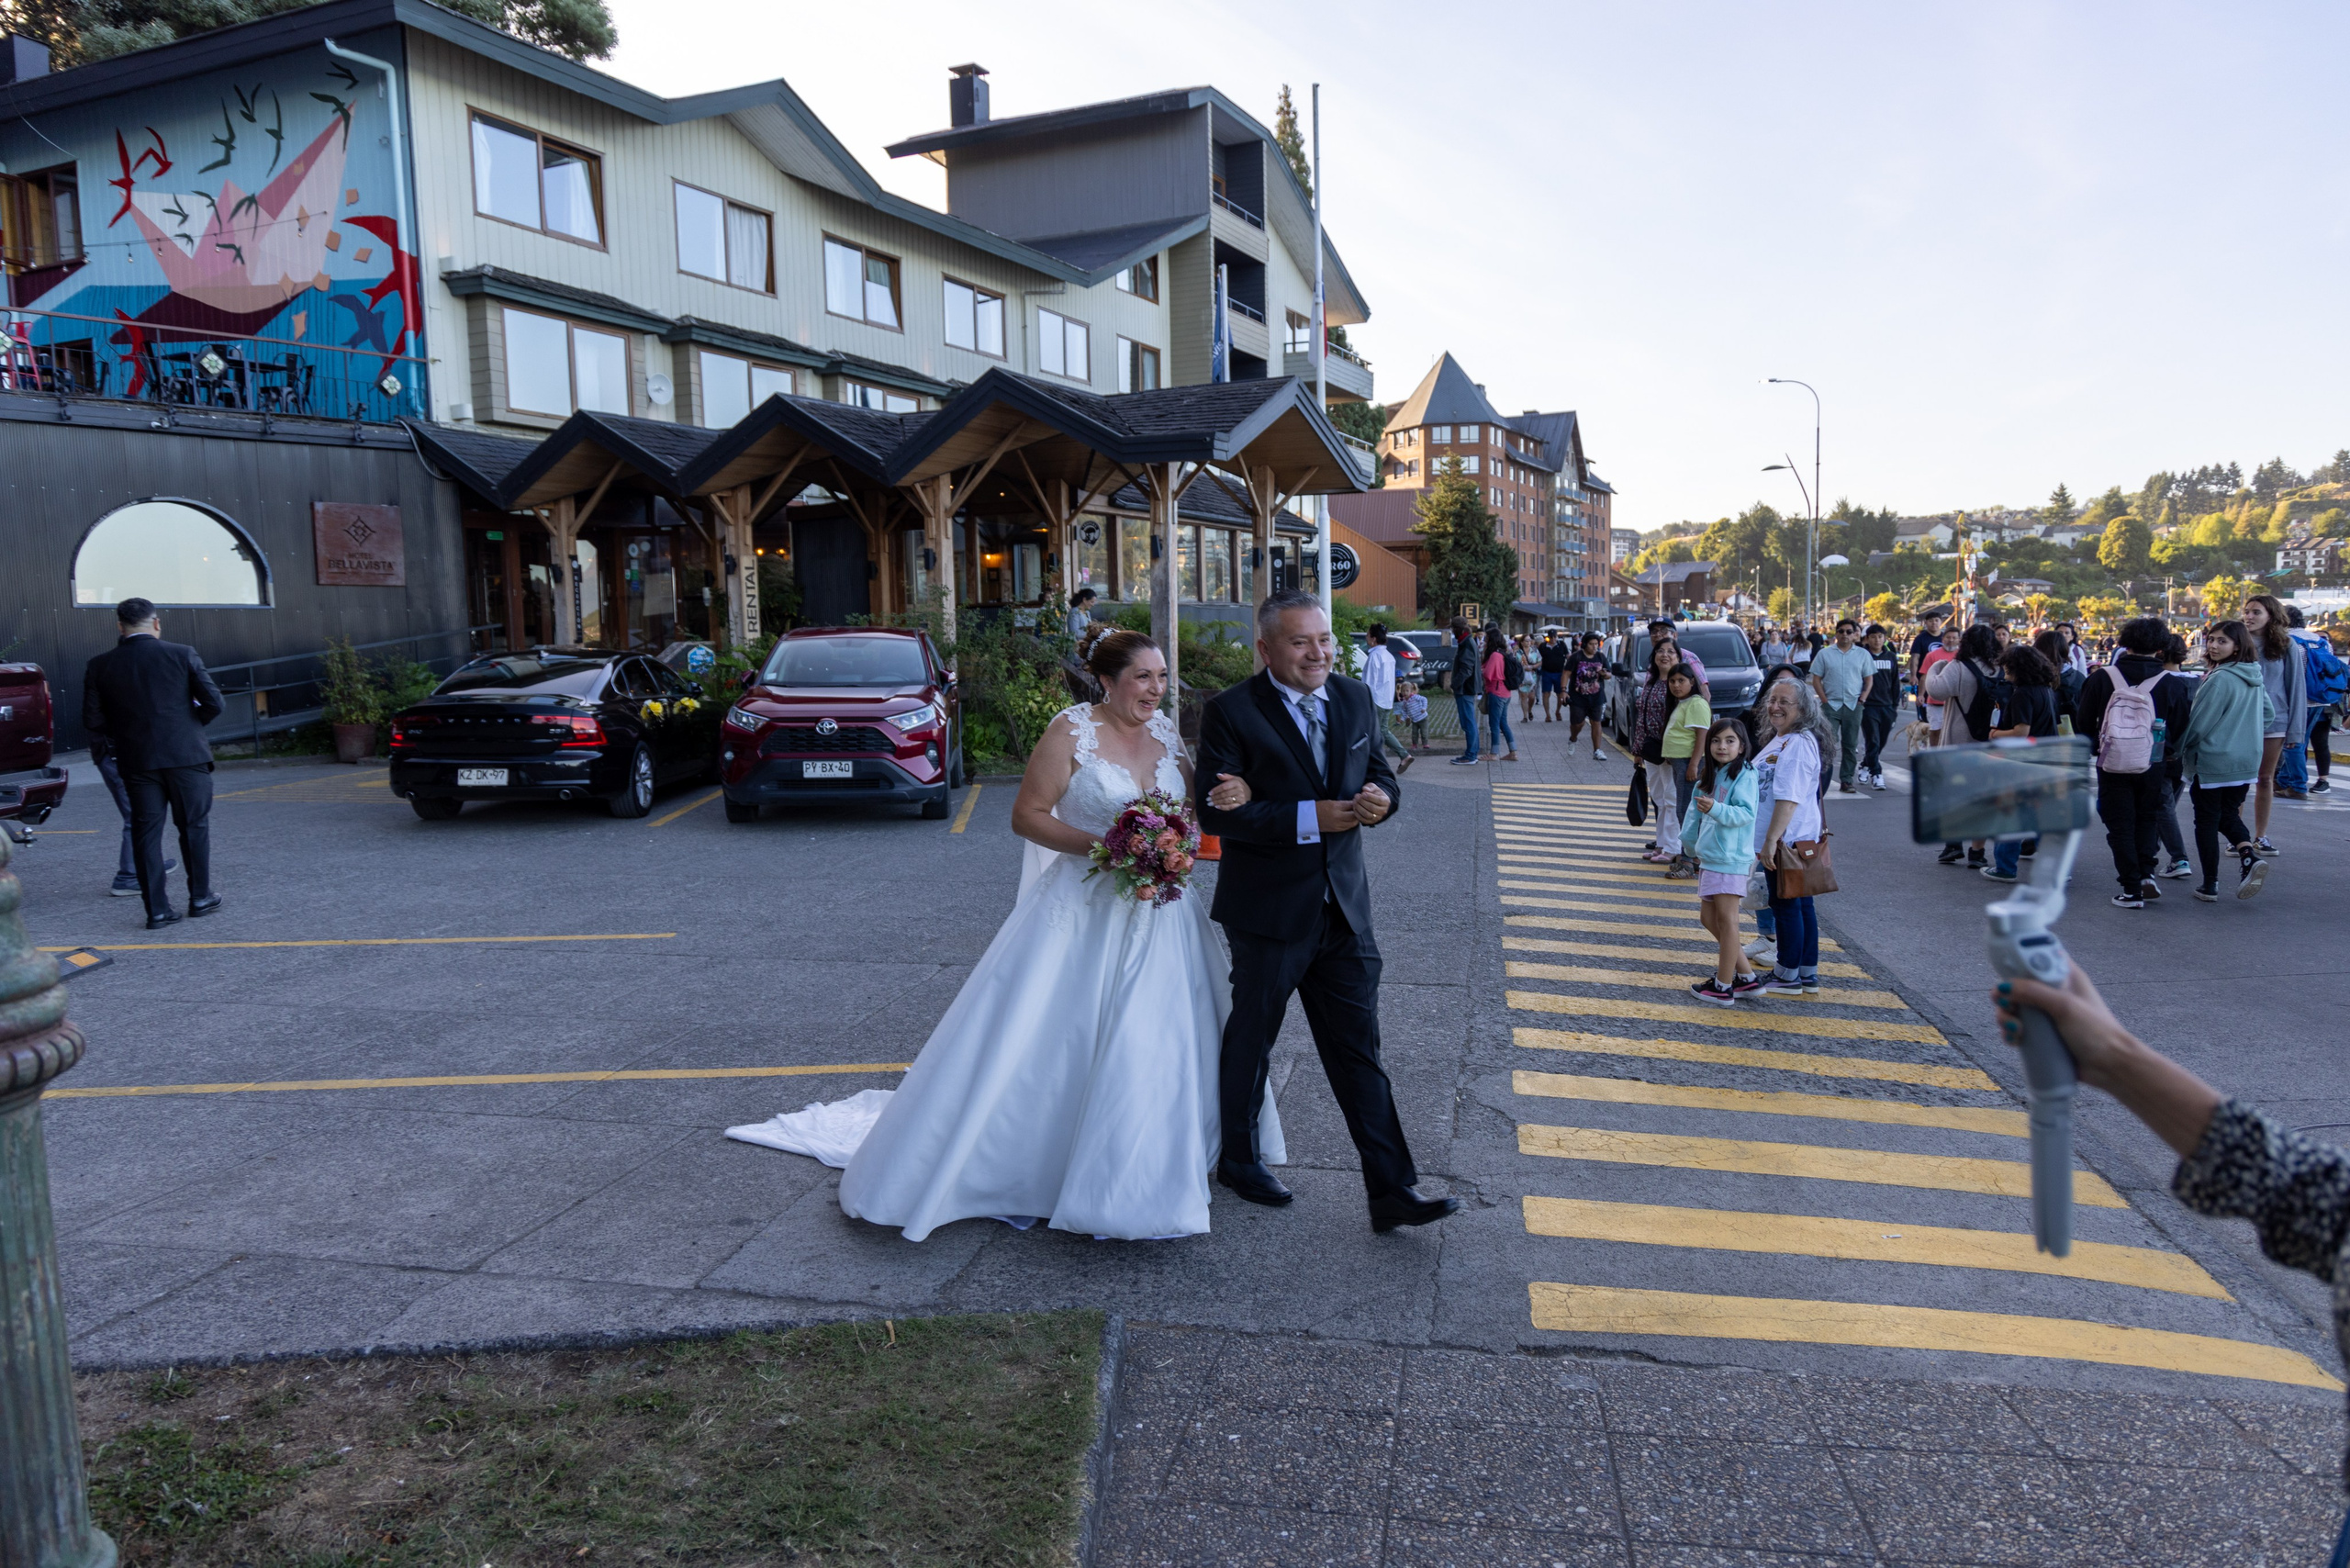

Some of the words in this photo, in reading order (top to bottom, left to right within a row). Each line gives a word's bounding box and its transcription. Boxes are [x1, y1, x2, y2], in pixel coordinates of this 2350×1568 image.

[328, 559, 395, 571] BELLAVISTA
[744, 559, 758, 633] RENTAL
[1465, 606, 1474, 618] E
